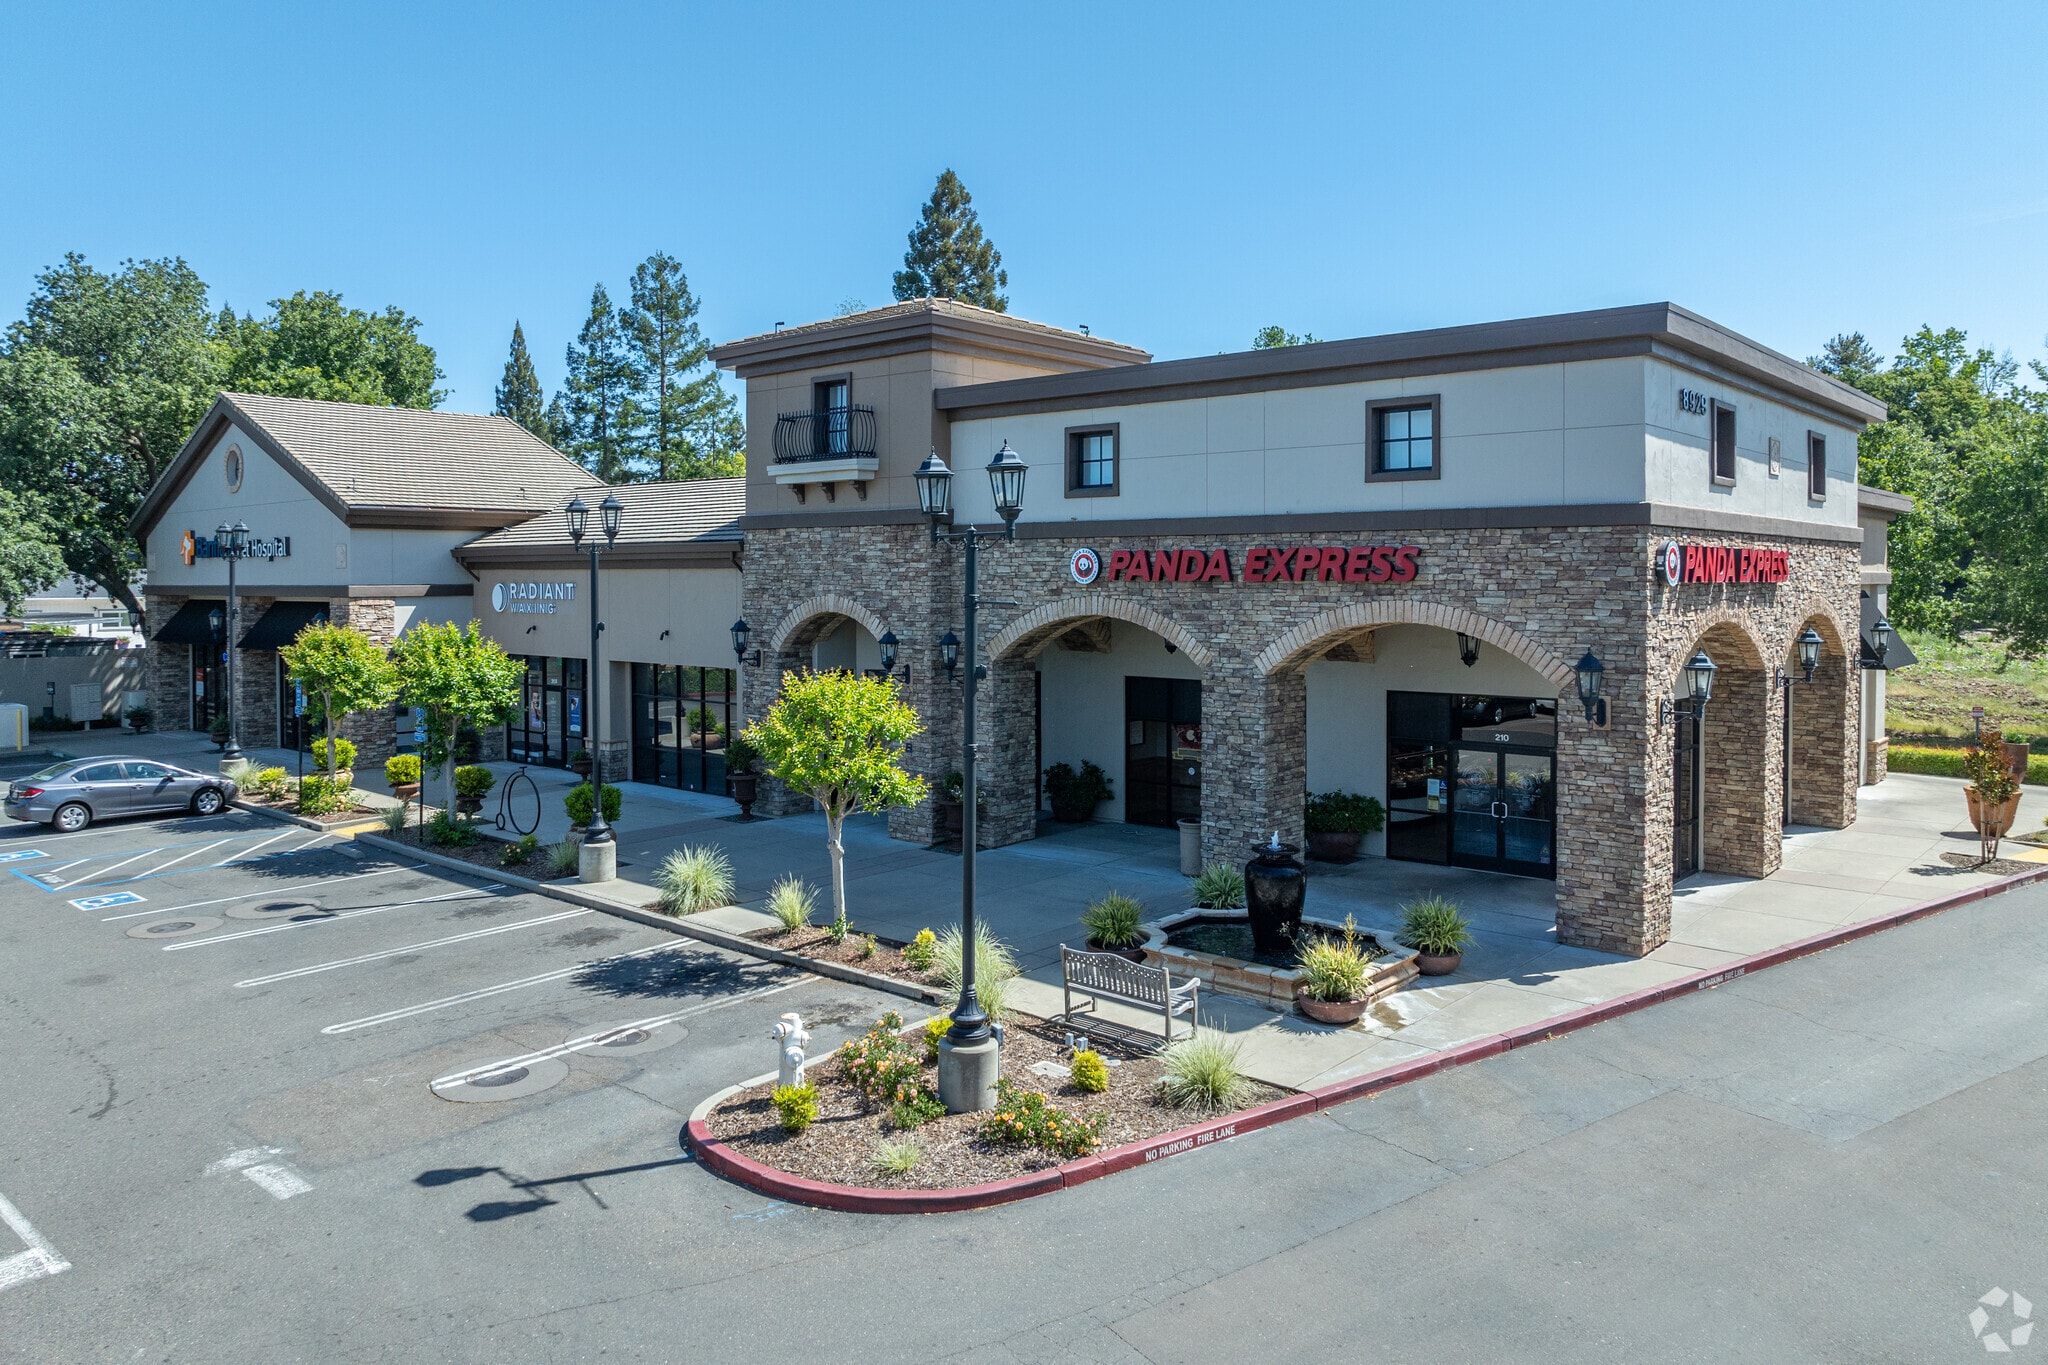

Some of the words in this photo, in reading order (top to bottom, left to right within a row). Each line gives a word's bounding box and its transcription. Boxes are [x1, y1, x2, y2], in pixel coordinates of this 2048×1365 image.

[1680, 387, 1706, 415] 8929
[252, 536, 289, 561] Hospital
[1108, 549, 1232, 582] PANDA
[1243, 546, 1421, 584] EXPRESS
[1684, 545, 1736, 584] PANDA
[1739, 548, 1789, 584] EXPRESS
[509, 582, 574, 600] RADIANT
[510, 603, 555, 614] WAXING
[1494, 734, 1510, 742] 210
[1146, 1151, 1158, 1162] NO
[1159, 1138, 1193, 1158] PARKING
[1197, 1132, 1214, 1145] FIRE
[1216, 1125, 1236, 1139] LANE
